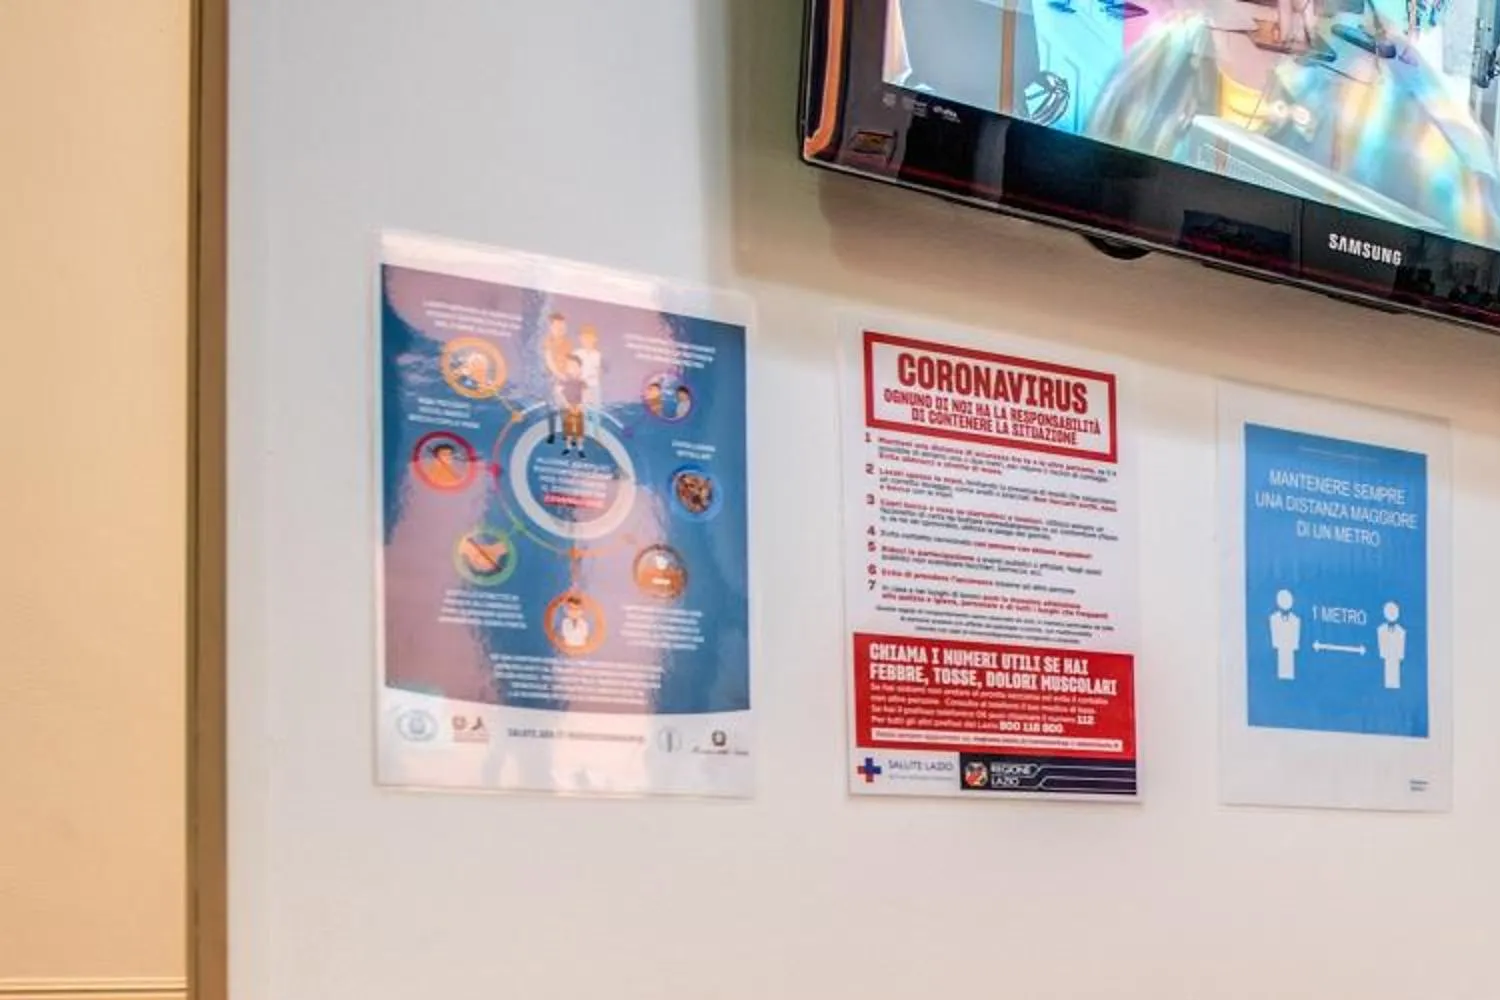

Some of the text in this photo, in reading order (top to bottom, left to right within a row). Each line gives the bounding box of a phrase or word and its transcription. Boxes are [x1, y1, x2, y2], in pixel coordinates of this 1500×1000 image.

[1328, 233, 1402, 266] SAMSUNG
[897, 353, 1089, 414] CORONAVIRUS
[884, 388, 932, 409] OGNUNO
[935, 395, 949, 410] DI
[952, 397, 974, 414] NOI
[976, 400, 990, 417] HA
[993, 403, 1006, 419] LA
[865, 432, 872, 443] 1
[912, 408, 1078, 446] DI CONTENERE LA SITUAZIONE
[865, 463, 874, 475] 2
[866, 493, 875, 505] 3
[1268, 469, 1407, 505] MANTENERE SEMPRE
[1255, 491, 1418, 530] UNA DISTANZA MAGGIORE
[867, 525, 876, 536] 4
[1297, 520, 1381, 547] DI UN METRO
[868, 541, 876, 552] 5
[868, 579, 877, 591] 7
[1312, 604, 1367, 626] 1 METRO
[869, 643, 1089, 675] CHIAMA I NUMERI UTILI SE HAI
[869, 663, 1118, 697] FEBBRE, TOSSE, DOLORI MUSCOLARI
[888, 759, 921, 770] SALUTE
